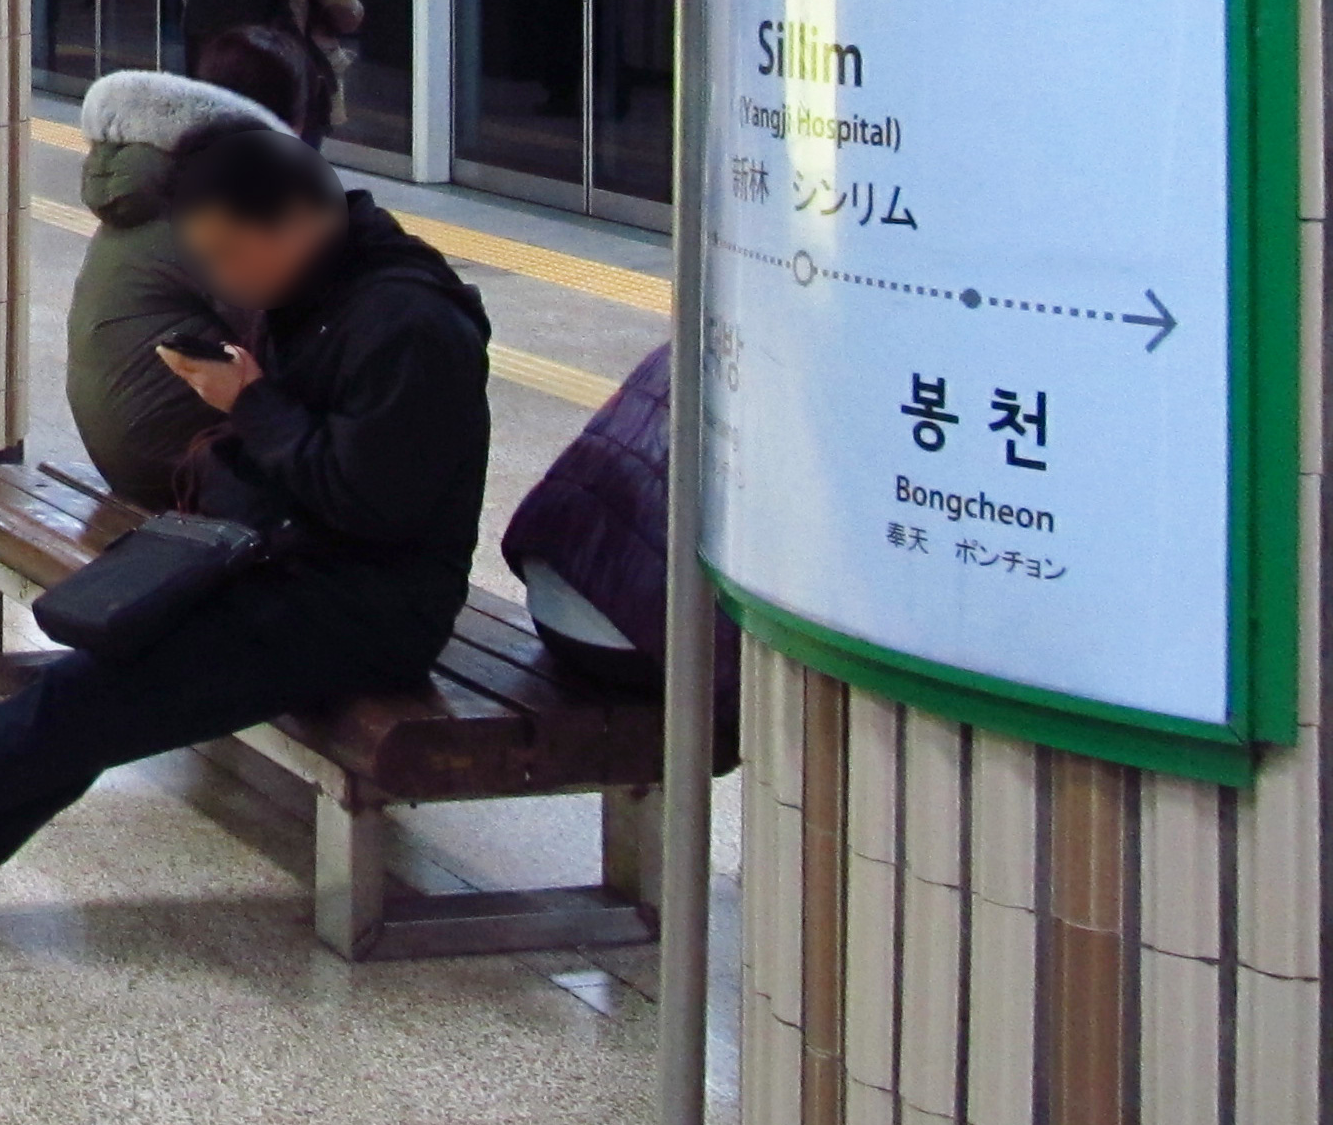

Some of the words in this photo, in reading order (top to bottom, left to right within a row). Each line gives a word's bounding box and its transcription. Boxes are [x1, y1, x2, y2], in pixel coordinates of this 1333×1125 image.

[758, 20, 863, 88] Sillim
[797, 106, 901, 153] Hospital)
[792, 170, 918, 230] シンリム
[895, 475, 1055, 533] Bongcheon
[886, 521, 930, 555] 奉天
[954, 538, 1067, 580] ポンチョン
